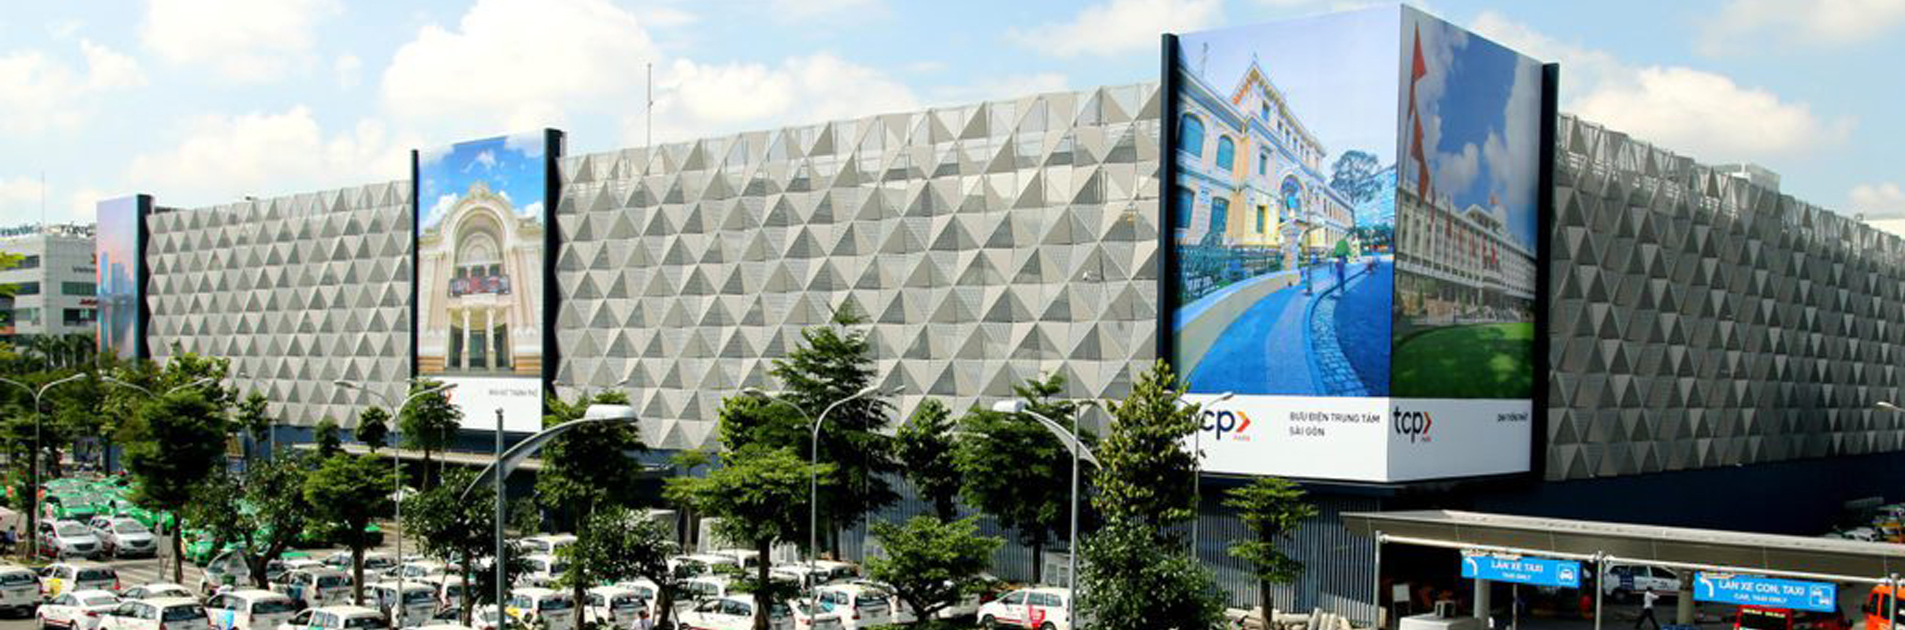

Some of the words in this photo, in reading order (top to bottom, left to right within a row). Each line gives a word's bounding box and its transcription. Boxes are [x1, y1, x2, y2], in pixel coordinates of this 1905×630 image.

[1331, 412, 1359, 423] TRUNG
[1393, 406, 1423, 443] tcp
[1525, 563, 1543, 572] TAXI
[1741, 582, 1754, 592] XE
[1783, 585, 1805, 596] TAXI
